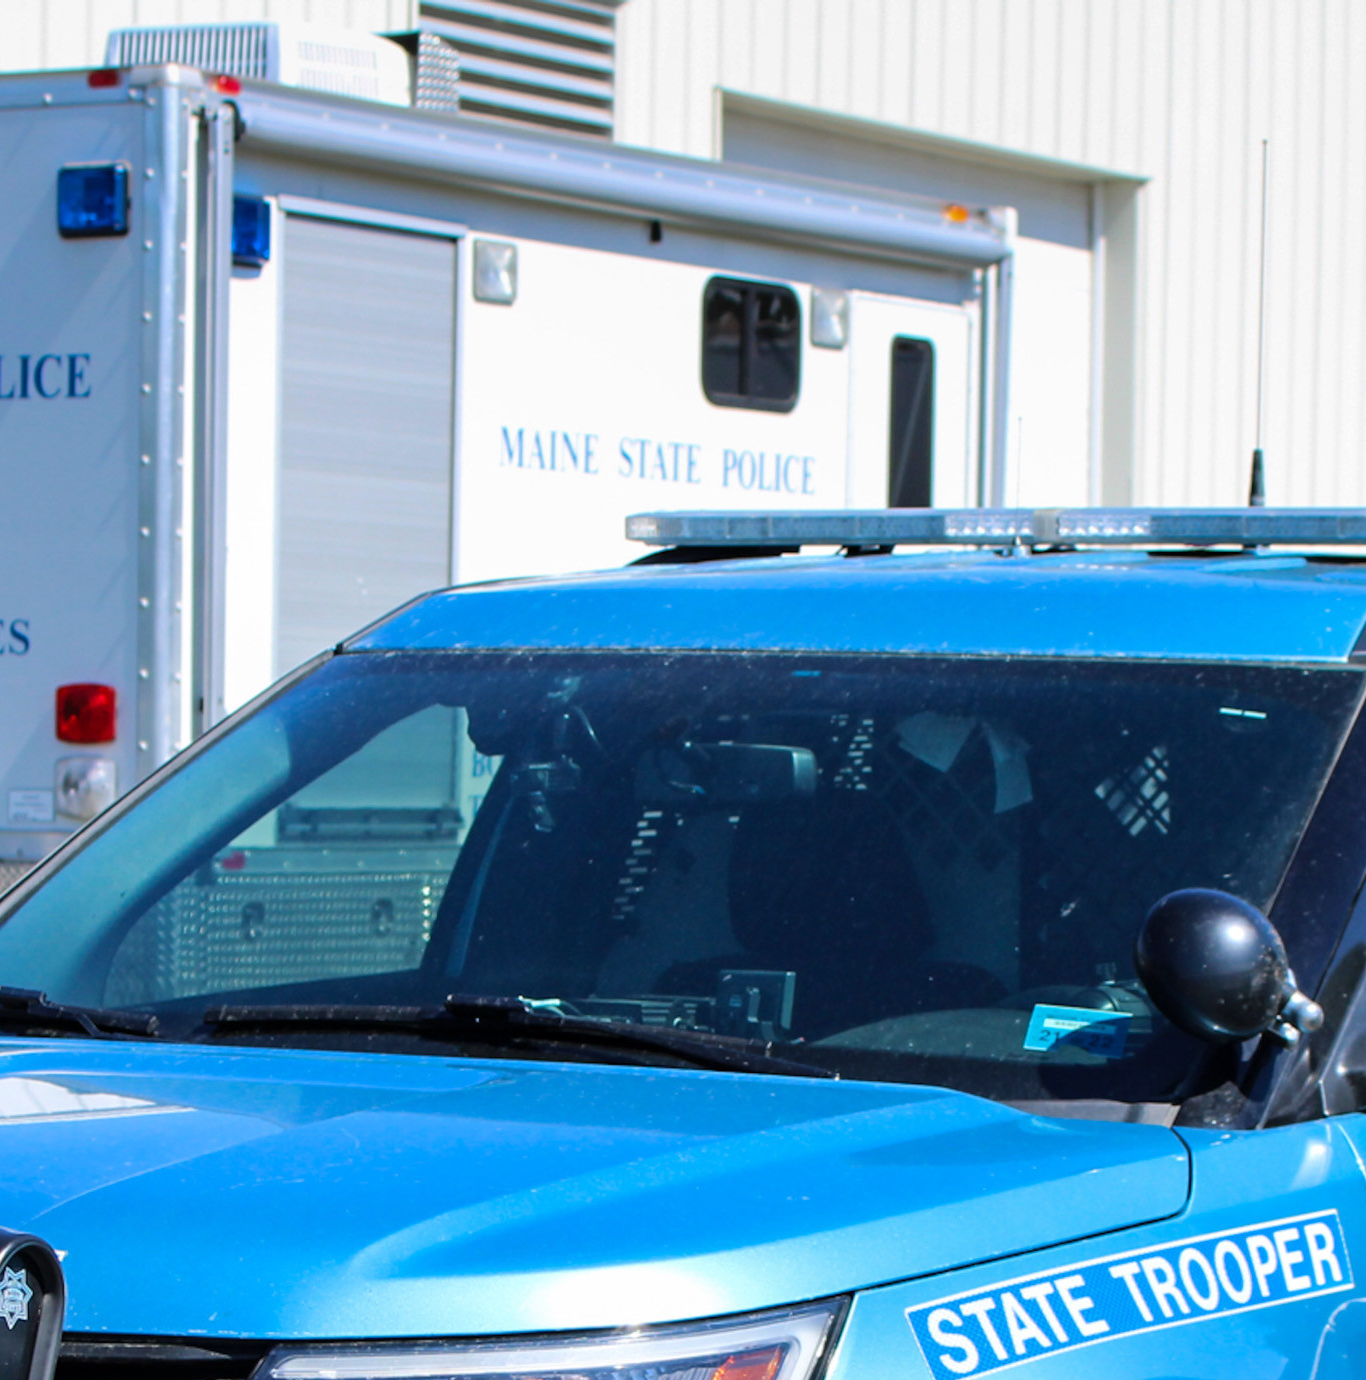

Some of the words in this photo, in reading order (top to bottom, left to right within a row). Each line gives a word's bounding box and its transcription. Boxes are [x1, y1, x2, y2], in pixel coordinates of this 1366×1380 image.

[499, 426, 599, 475] MAINE
[618, 437, 701, 485] STATE
[723, 448, 816, 495] POLICE
[927, 1274, 1110, 1375] STATE
[1110, 1222, 1343, 1322] TROOPER
